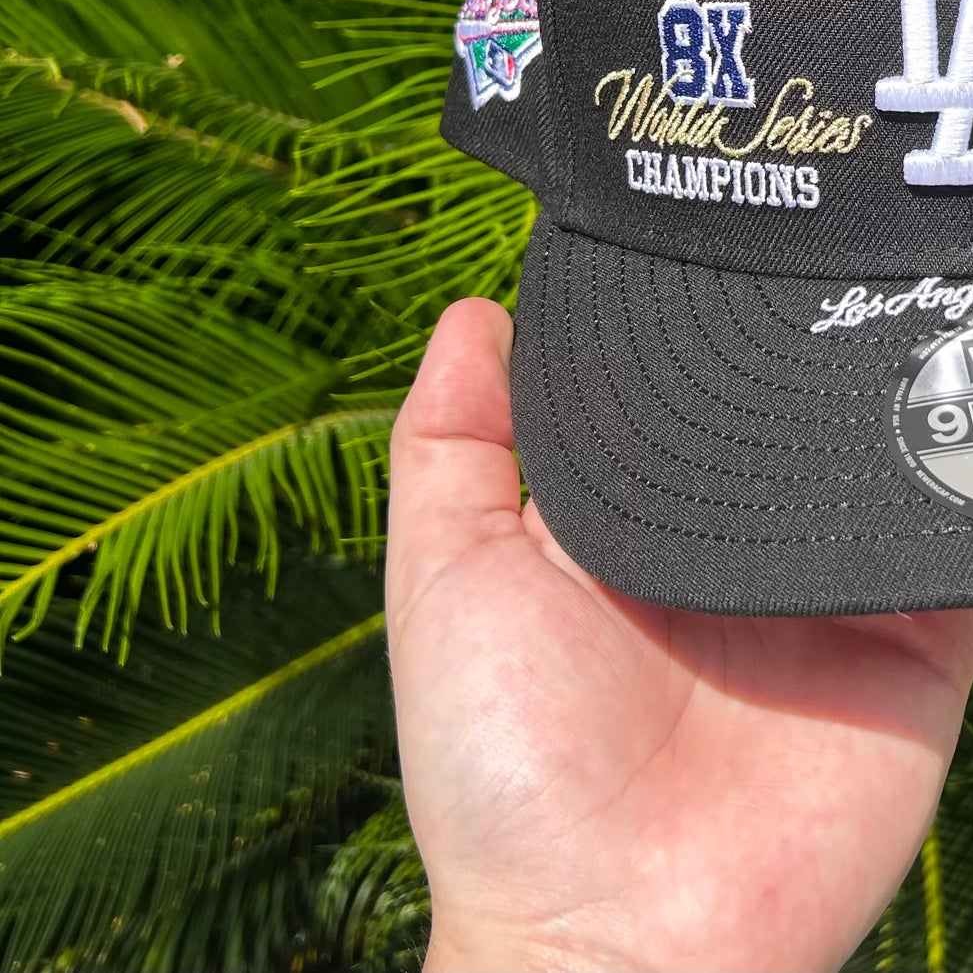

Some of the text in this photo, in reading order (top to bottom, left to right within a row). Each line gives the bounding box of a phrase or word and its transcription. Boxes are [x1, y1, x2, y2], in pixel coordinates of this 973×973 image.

[657, 0, 756, 108] 8X
[712, 78, 873, 158] Series
[625, 149, 820, 209] CHAMPIONS
[811, 285, 884, 332] Los
